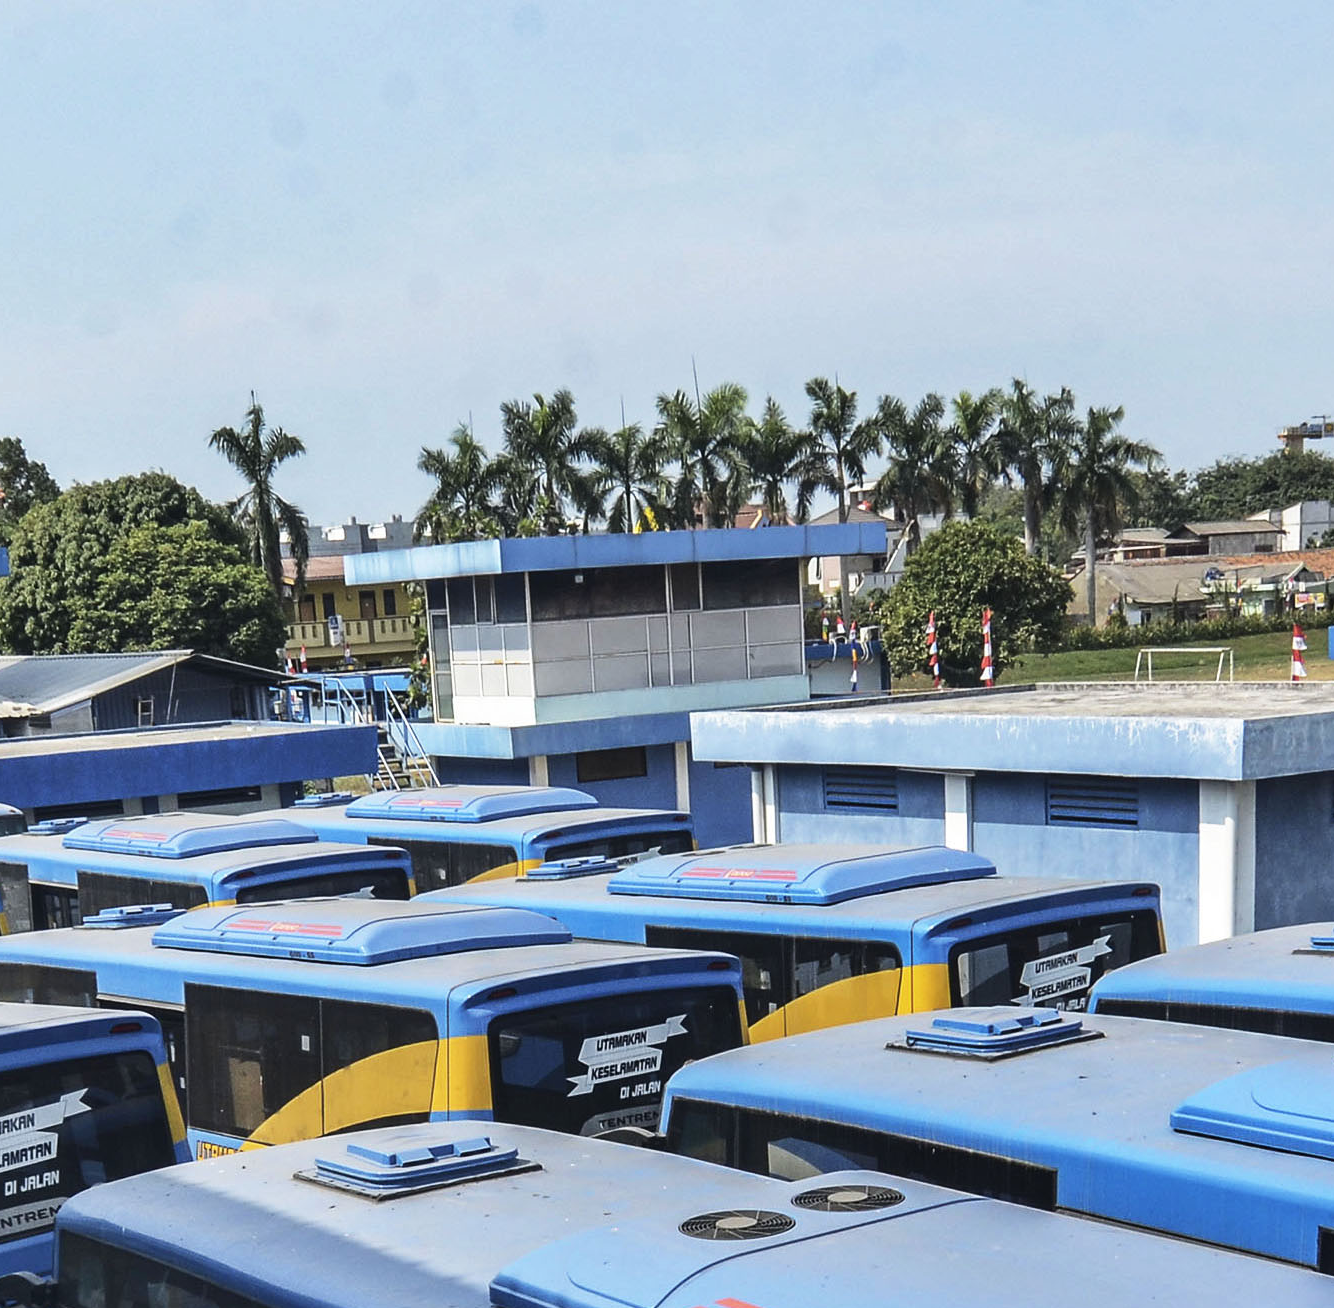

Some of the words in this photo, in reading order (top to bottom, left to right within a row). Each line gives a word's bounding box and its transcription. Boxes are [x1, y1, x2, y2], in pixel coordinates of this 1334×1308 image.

[1035, 952, 1078, 974] UTAMAKAN
[1031, 974, 1087, 999] KESELAMATAN
[1067, 997, 1087, 1011] JALA
[596, 1030, 647, 1051] UTAMAKAN
[591, 1055, 658, 1081] KESELAMATAN
[620, 1086, 630, 1100] DI
[632, 1080, 661, 1098] JALAN
[4, 1181, 17, 1197] DI
[20, 1169, 60, 1194] JALAN
